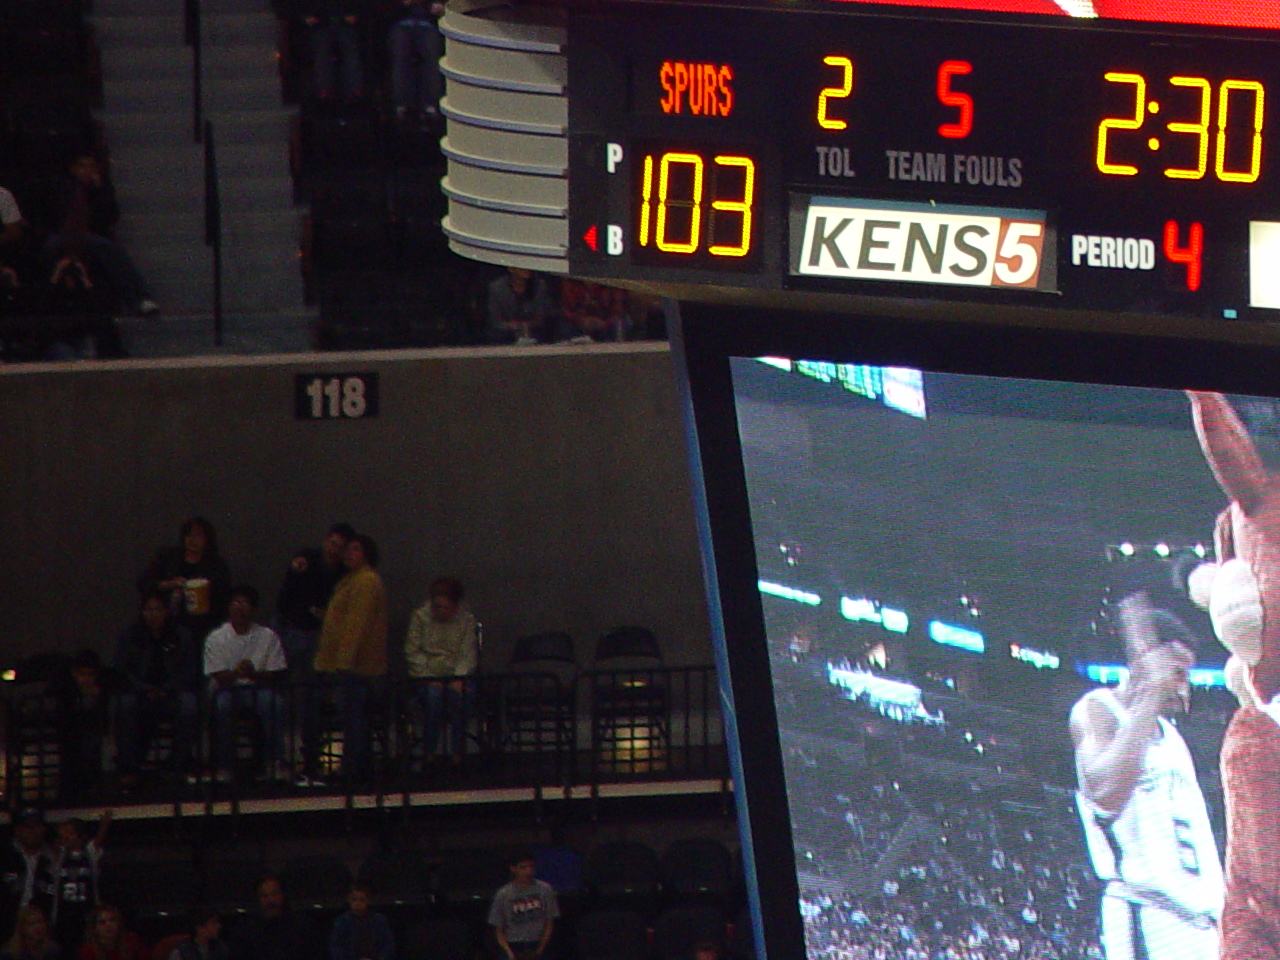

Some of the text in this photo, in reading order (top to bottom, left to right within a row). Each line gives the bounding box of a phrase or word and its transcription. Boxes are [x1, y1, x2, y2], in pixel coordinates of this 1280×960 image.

[659, 61, 734, 117] SPURS
[817, 56, 853, 129] 2
[937, 60, 974, 139] 5
[1096, 72, 1264, 182] 2:30
[607, 142, 623, 174] P
[816, 146, 855, 178] TOL
[886, 149, 1023, 188] TEAM FOULS
[640, 153, 755, 257] 103
[607, 224, 623, 256] B
[1072, 234, 1155, 270] PERIOD
[1163, 219, 1202, 291] 4
[307, 376, 366, 418] 118
